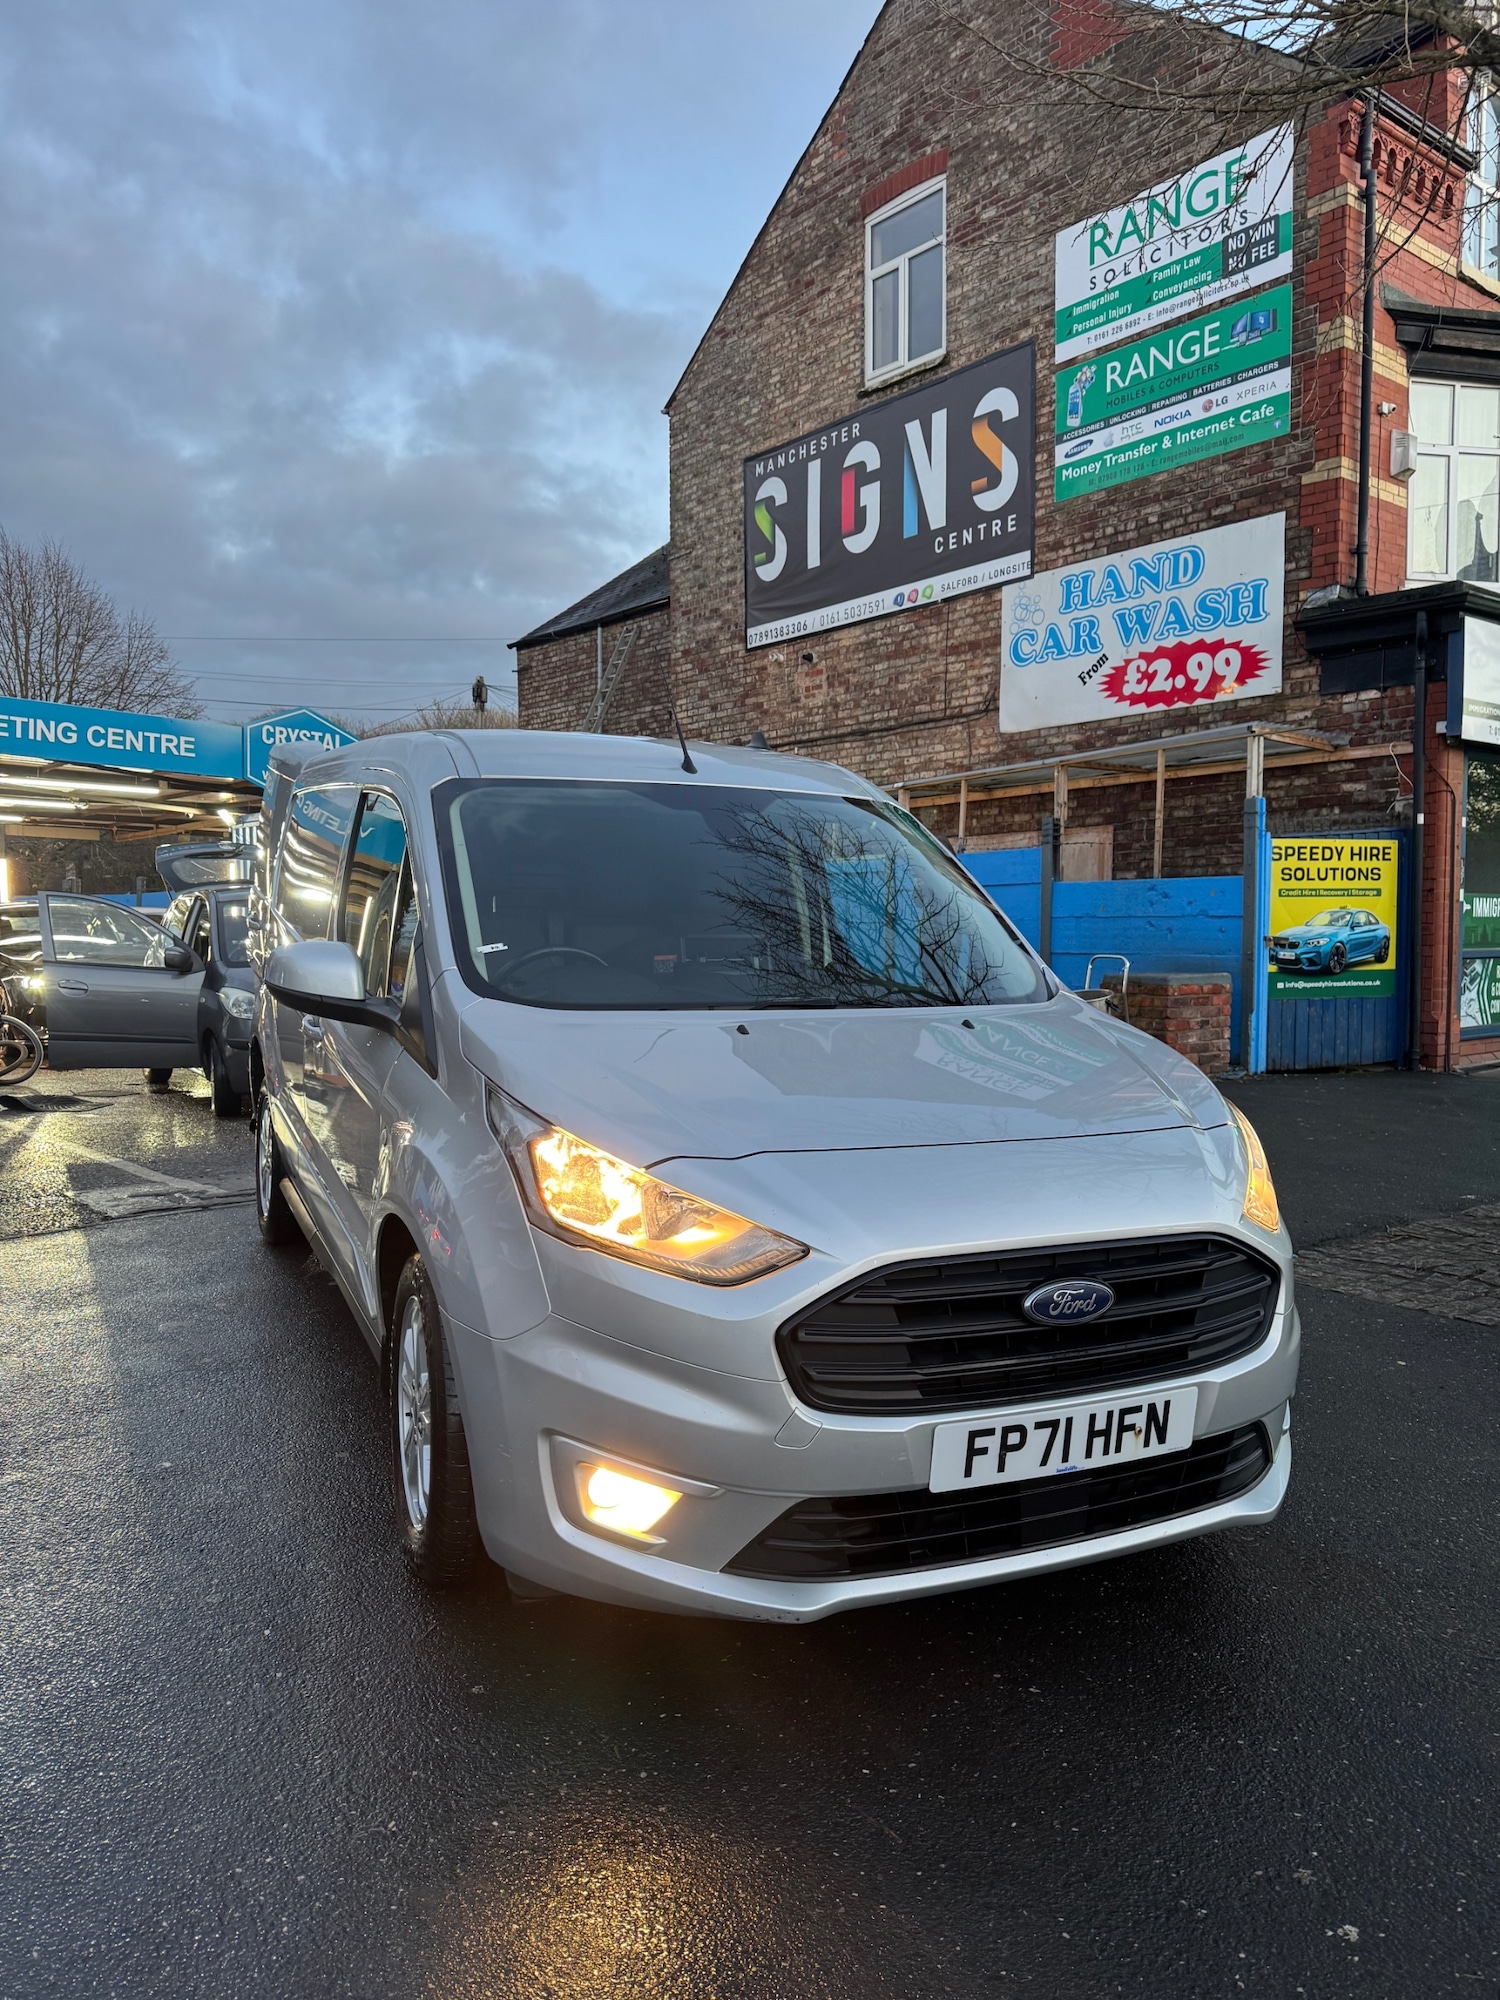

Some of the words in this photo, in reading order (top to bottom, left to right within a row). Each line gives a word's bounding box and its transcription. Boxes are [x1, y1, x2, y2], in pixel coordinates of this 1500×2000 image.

[1089, 153, 1248, 266] RANGE
[1089, 210, 1248, 291] SOLICITORS
[1228, 235, 1246, 253] NO
[1250, 220, 1275, 244] WIN
[1153, 261, 1181, 283] Family
[1184, 254, 1202, 270] Law
[1228, 253, 1246, 271] NO
[1251, 241, 1275, 263] FEE
[1153, 269, 1212, 300] Conveyancing
[1073, 290, 1119, 317] Immigration
[1073, 313, 1106, 334] Personal
[1109, 302, 1132, 324] Injury
[1094, 330, 1109, 343] 0161
[1111, 324, 1123, 336] 226
[1125, 318, 1141, 331] 6892
[1106, 321, 1221, 393] RANGE
[1063, 421, 1105, 441] ACCESSORIES
[1109, 407, 1147, 425] UNLOCKING
[1151, 392, 1188, 410] REPAIRING
[1193, 377, 1232, 396] BATTERIES
[1237, 361, 1279, 381] CHARGERS
[1106, 386, 1146, 410] MOBILES
[1149, 385, 1155, 395] &
[1158, 361, 1220, 391] COMPUTERS
[1215, 396, 1229, 408] LG
[1236, 381, 1277, 401] XPERIA
[1154, 409, 1192, 428] NOKIA
[755, 422, 861, 477] MANCHESTER
[1062, 460, 1102, 482] Money
[1103, 442, 1158, 468] Transfer
[1162, 435, 1172, 449] &
[1177, 416, 1235, 445] Internet
[1240, 403, 1274, 424] Cafe
[754, 386, 1019, 582] SIGNS
[934, 513, 1017, 554] CENTRE
[941, 574, 978, 593] SALFORD
[988, 560, 1031, 580] LONGSITE
[1058, 545, 1205, 614] HAND
[748, 620, 808, 645] 07891383306
[819, 610, 841, 627] 0161
[844, 599, 886, 619] 5037591
[1009, 615, 1103, 667] CAR
[1112, 578, 1268, 648] WASH
[1078, 653, 1109, 686] From
[1122, 648, 1242, 696] £2.99
[87, 725, 196, 758] CENTRE
[1272, 846, 1344, 861] SPEEDY
[1350, 846, 1392, 861] HIRE
[1281, 867, 1381, 881] SOLUTIONS
[1320, 889, 1349, 897] Recovery
[1352, 889, 1377, 897] Storage
[1285, 979, 1381, 990] info@speedyhiresolutions.co.uk
[1049, 1288, 1097, 1316] Ford
[964, 1416, 1073, 1478] FP71
[1085, 1400, 1171, 1459] HFN
